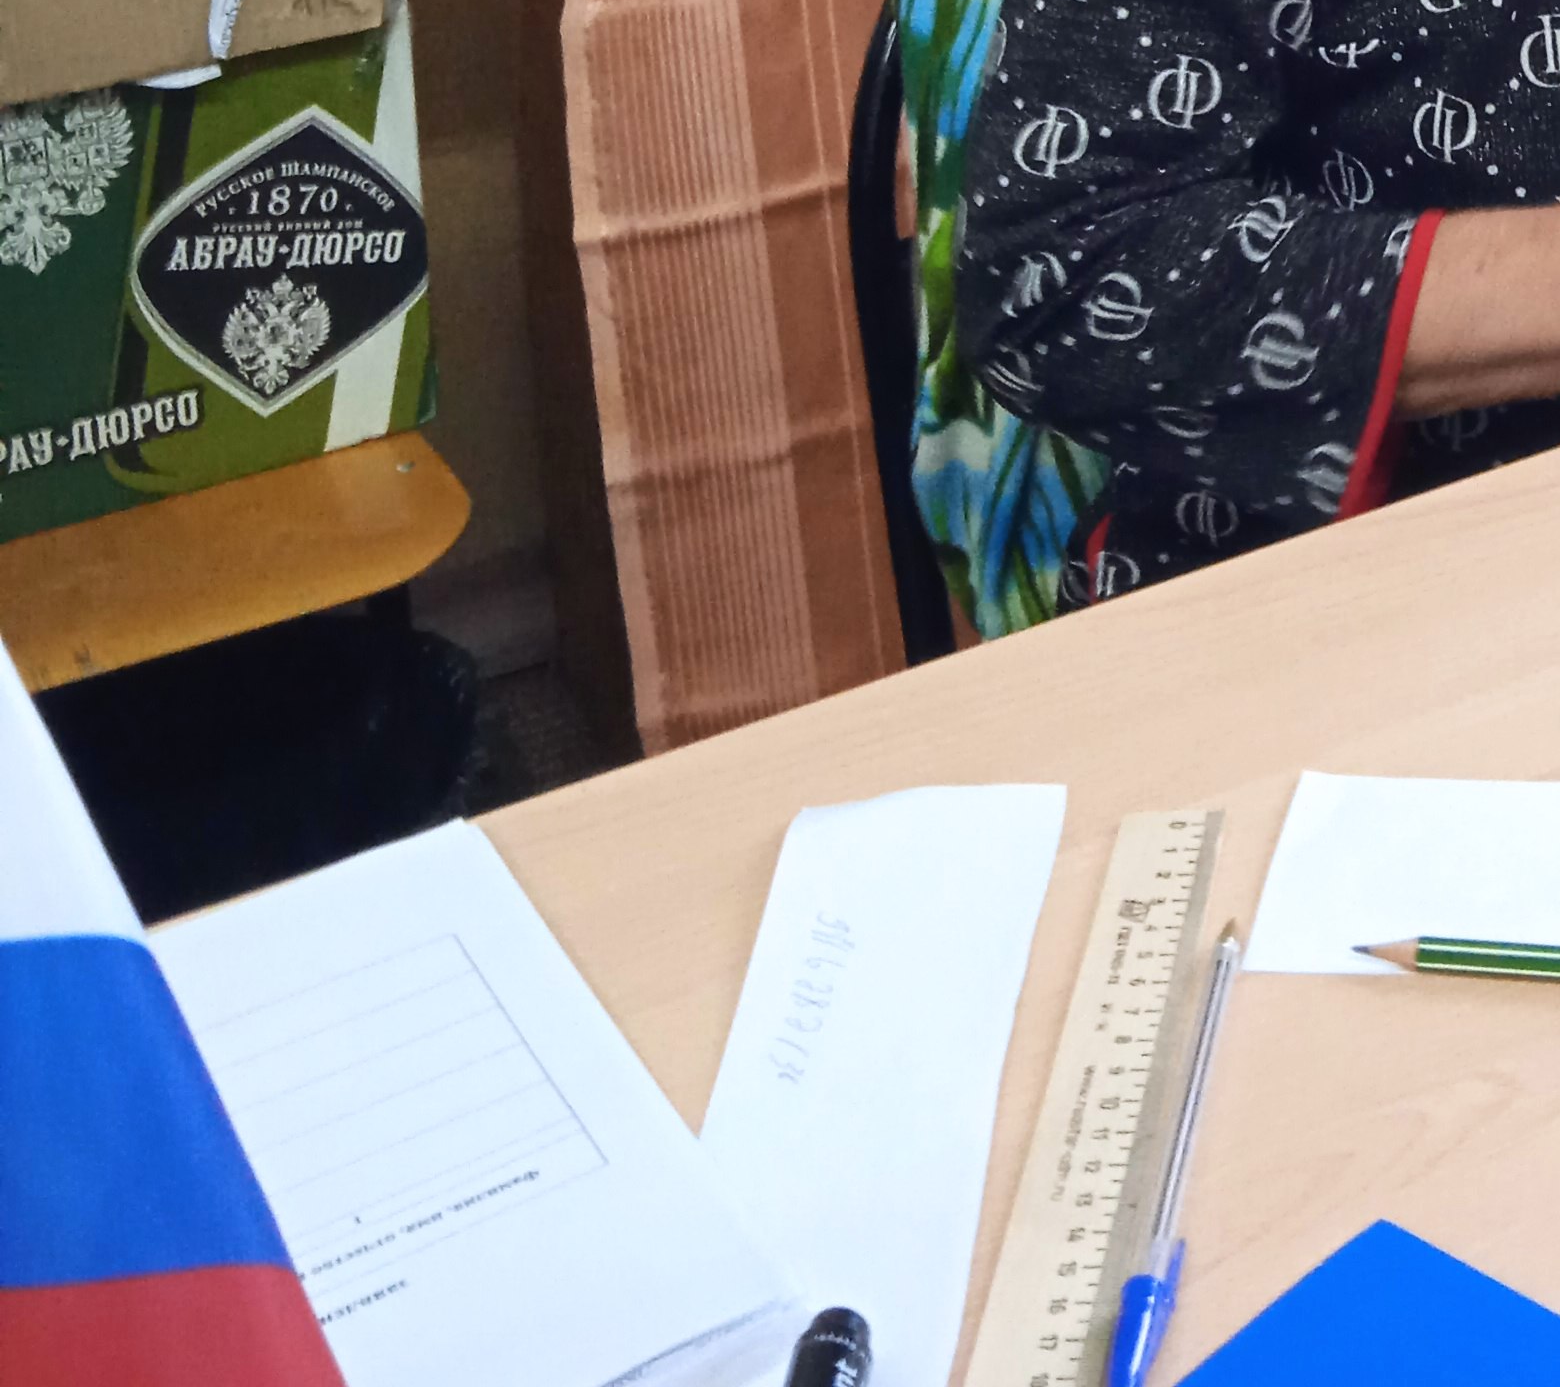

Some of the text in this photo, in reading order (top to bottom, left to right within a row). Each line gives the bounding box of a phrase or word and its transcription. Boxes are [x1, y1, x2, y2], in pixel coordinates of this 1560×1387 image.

[193, 160, 397, 219] РУССКОЕ ШАМПАНСКОЕ
[248, 183, 339, 216] 1870
